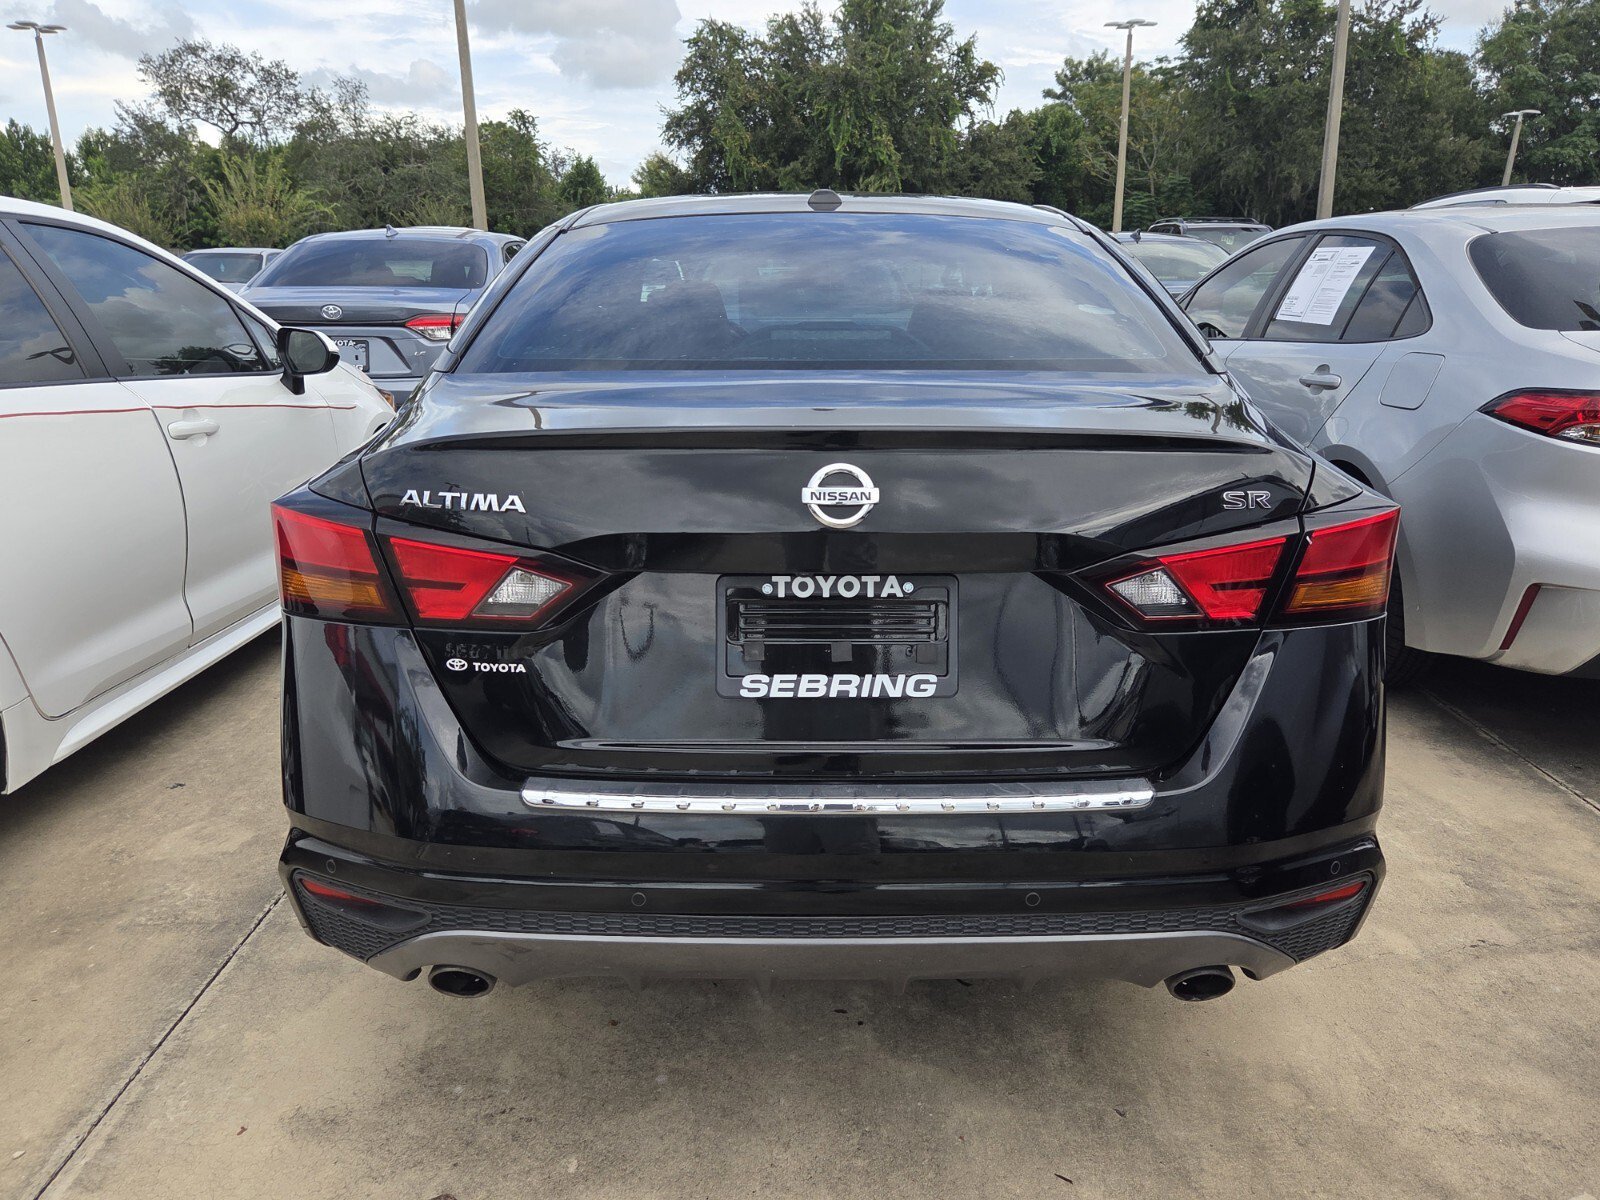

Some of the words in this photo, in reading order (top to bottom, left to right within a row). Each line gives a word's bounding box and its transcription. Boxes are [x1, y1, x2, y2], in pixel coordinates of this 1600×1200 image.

[399, 489, 527, 514] ALTIMA
[810, 491, 871, 502] NISSAN
[1222, 490, 1272, 510] SR
[771, 575, 904, 598] TOYOTA
[473, 662, 526, 673] TOYOTA
[739, 674, 938, 698] SEBRING
